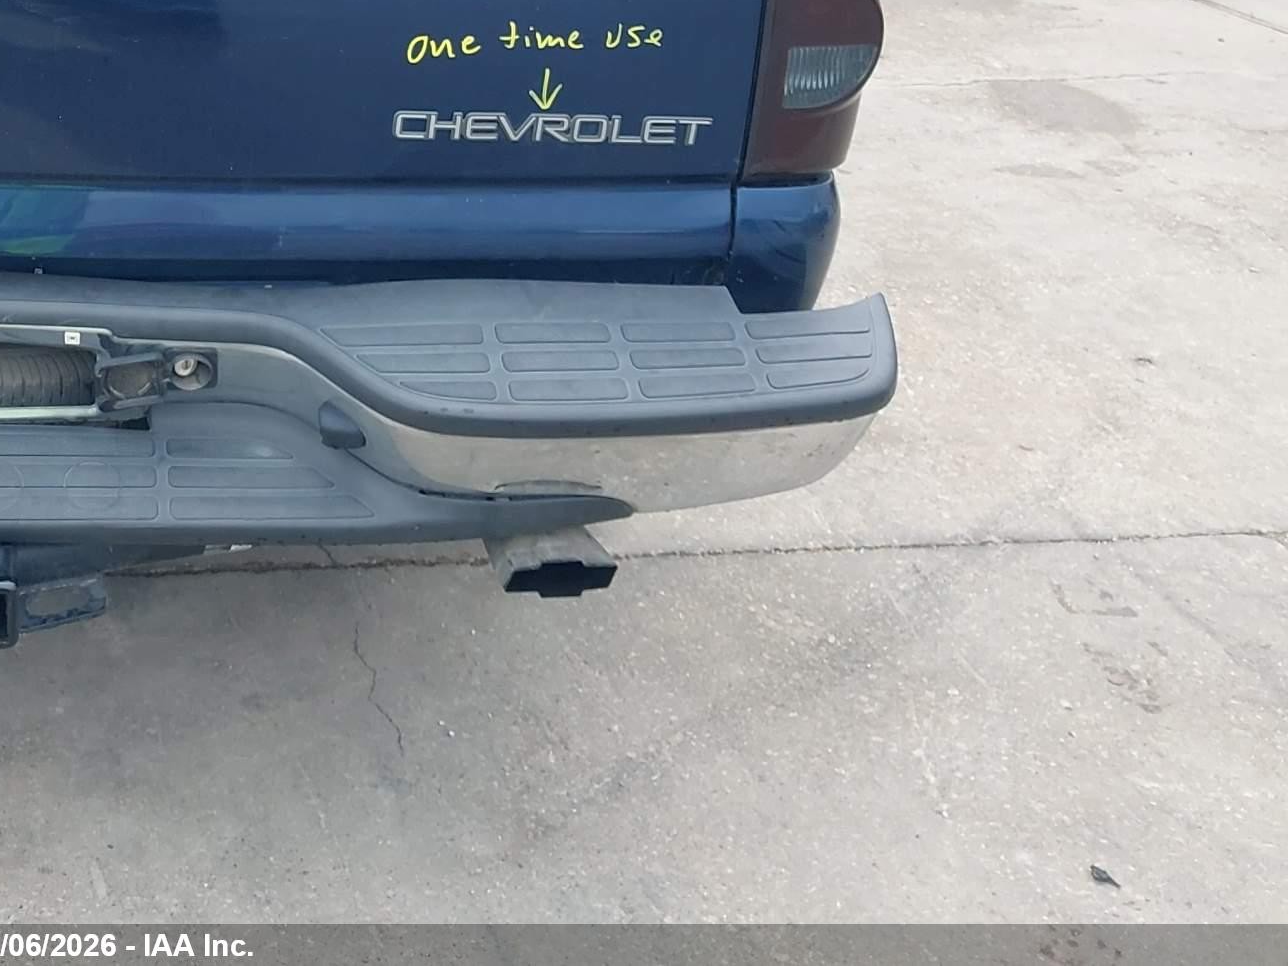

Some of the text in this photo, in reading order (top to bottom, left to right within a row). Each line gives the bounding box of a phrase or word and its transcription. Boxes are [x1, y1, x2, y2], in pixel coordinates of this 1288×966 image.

[407, 34, 482, 64] one
[498, 20, 585, 50] time
[393, 110, 714, 145] CHEVROLET
